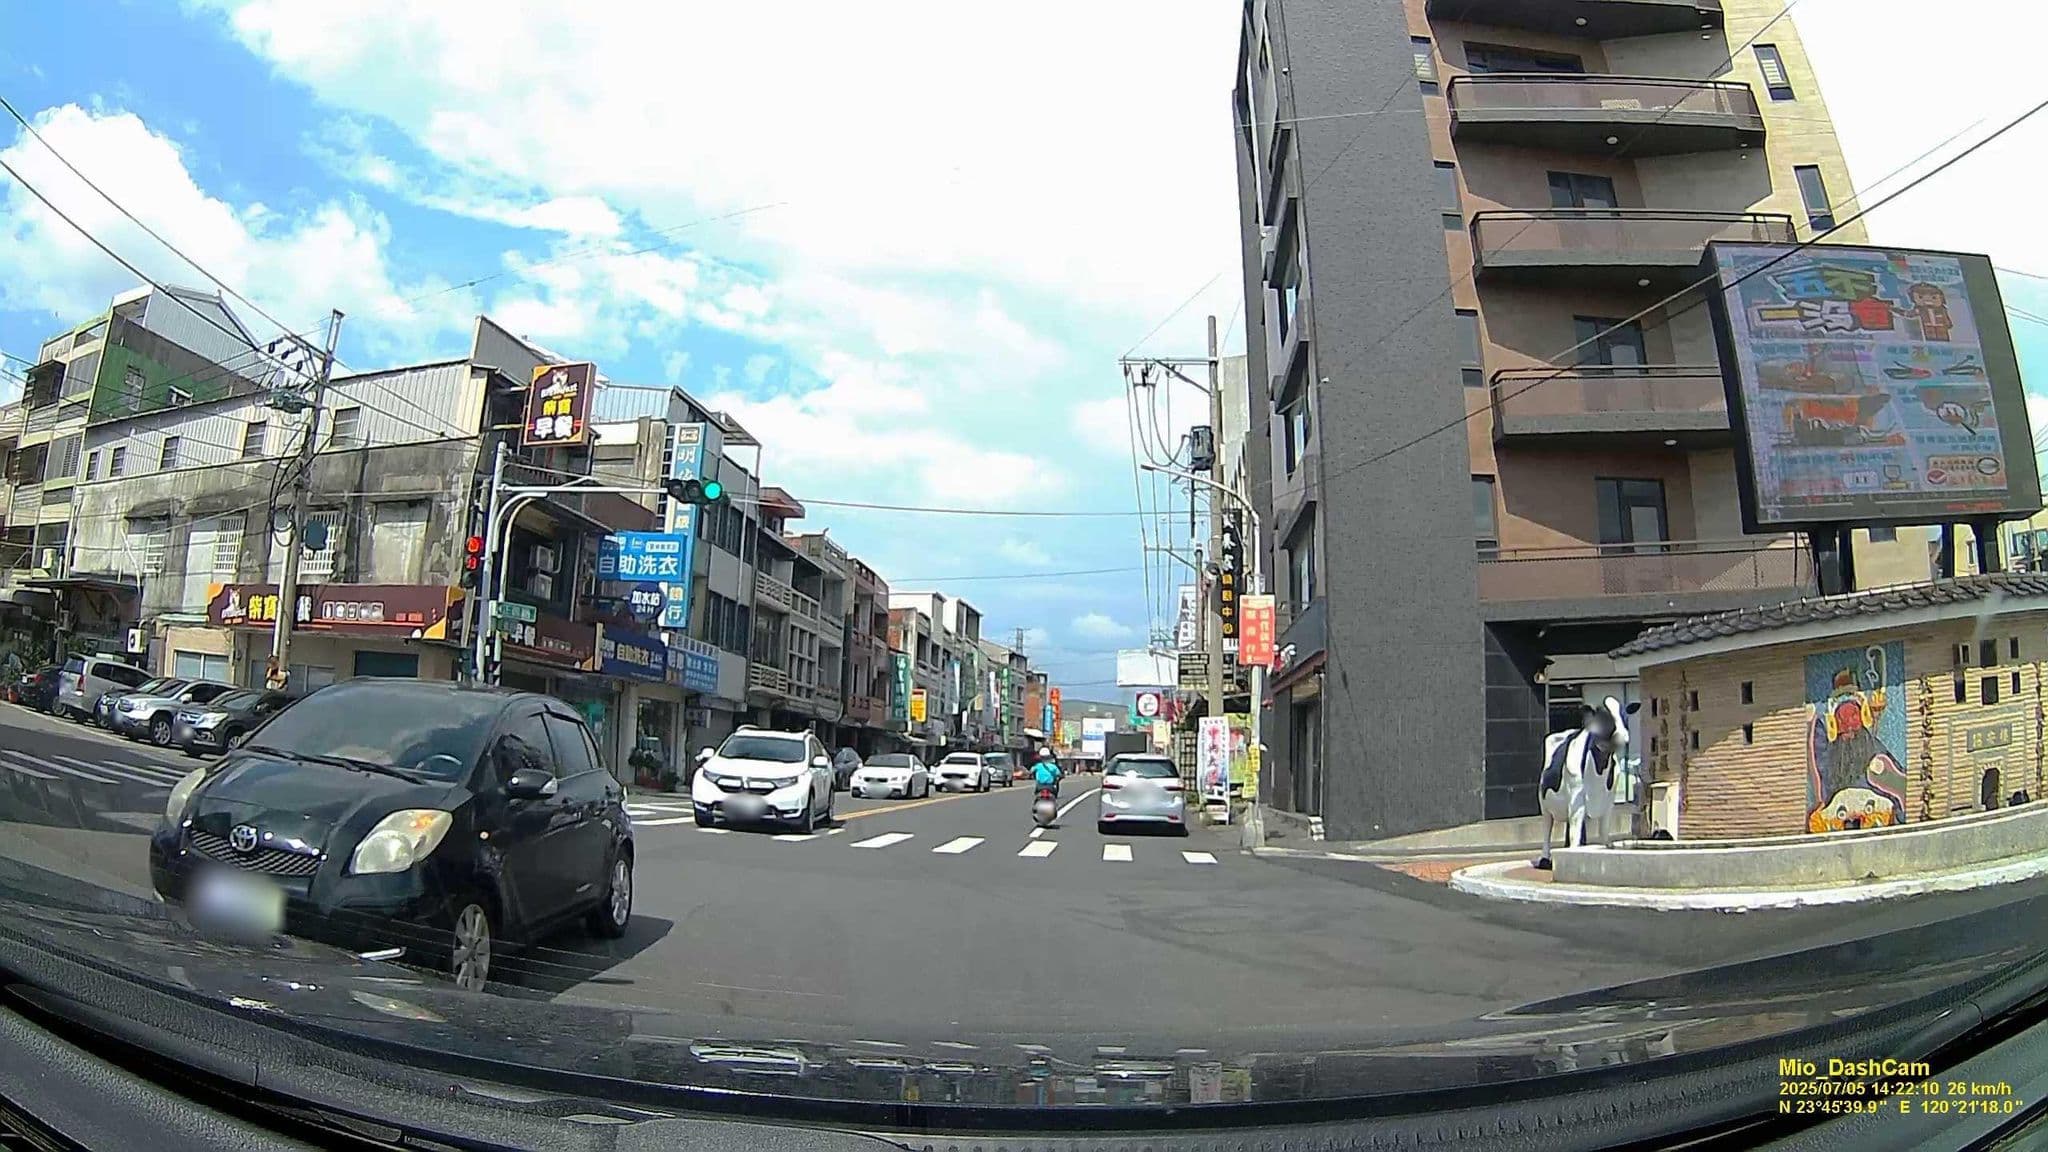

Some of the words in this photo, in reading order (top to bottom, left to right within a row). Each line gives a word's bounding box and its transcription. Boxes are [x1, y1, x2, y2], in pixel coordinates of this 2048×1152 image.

[535, 415, 573, 439] 早餐
[599, 554, 678, 576] 自助洗衣
[631, 590, 660, 607] 加水站
